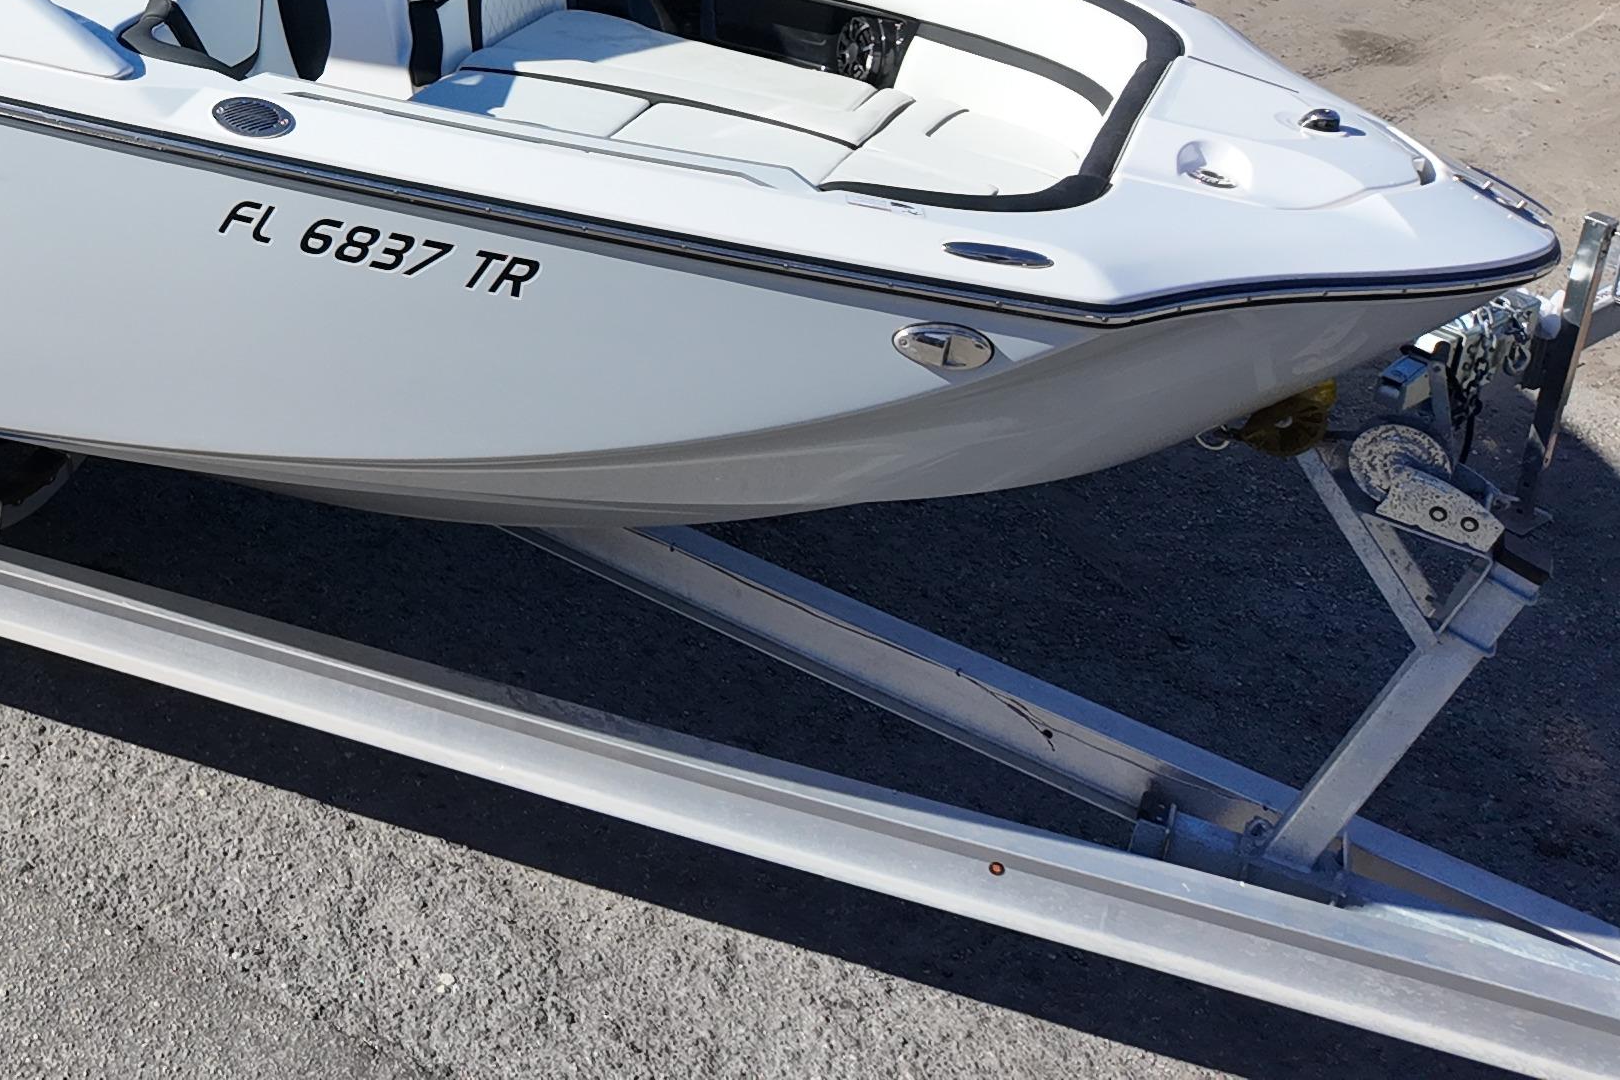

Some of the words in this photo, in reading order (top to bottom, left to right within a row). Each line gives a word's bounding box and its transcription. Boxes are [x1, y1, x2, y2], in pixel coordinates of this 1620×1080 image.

[218, 200, 276, 244] FL
[299, 218, 456, 277] 6837
[465, 249, 541, 298] TR
